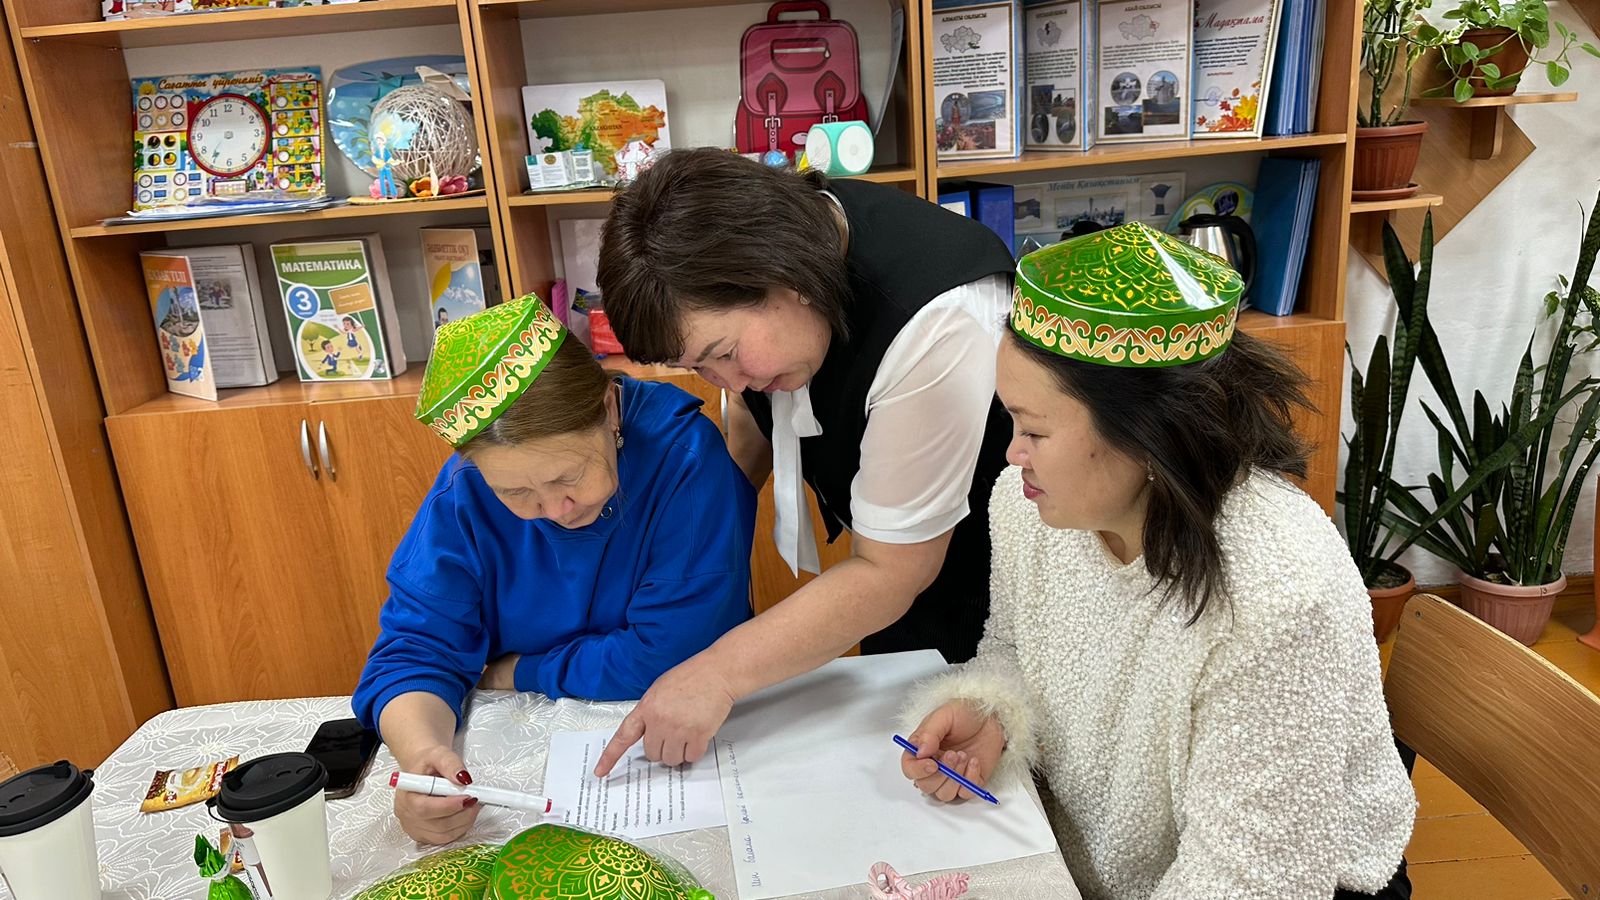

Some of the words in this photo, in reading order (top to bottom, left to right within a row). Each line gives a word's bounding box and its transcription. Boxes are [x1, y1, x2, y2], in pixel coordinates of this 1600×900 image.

[224, 104, 232, 112] 12
[240, 107, 245, 115] 1
[210, 109, 218, 117] 11
[202, 119, 211, 127] 10
[249, 115, 255, 124] 2
[197, 133, 203, 141] 9
[254, 129, 260, 137] 3
[201, 146, 207, 154] 8
[250, 142, 256, 151] 4
[241, 153, 247, 162] 5
[227, 158, 232, 166] 6
[281, 259, 363, 273] МАТЕМАТИКА
[295, 290, 312, 311] 3
